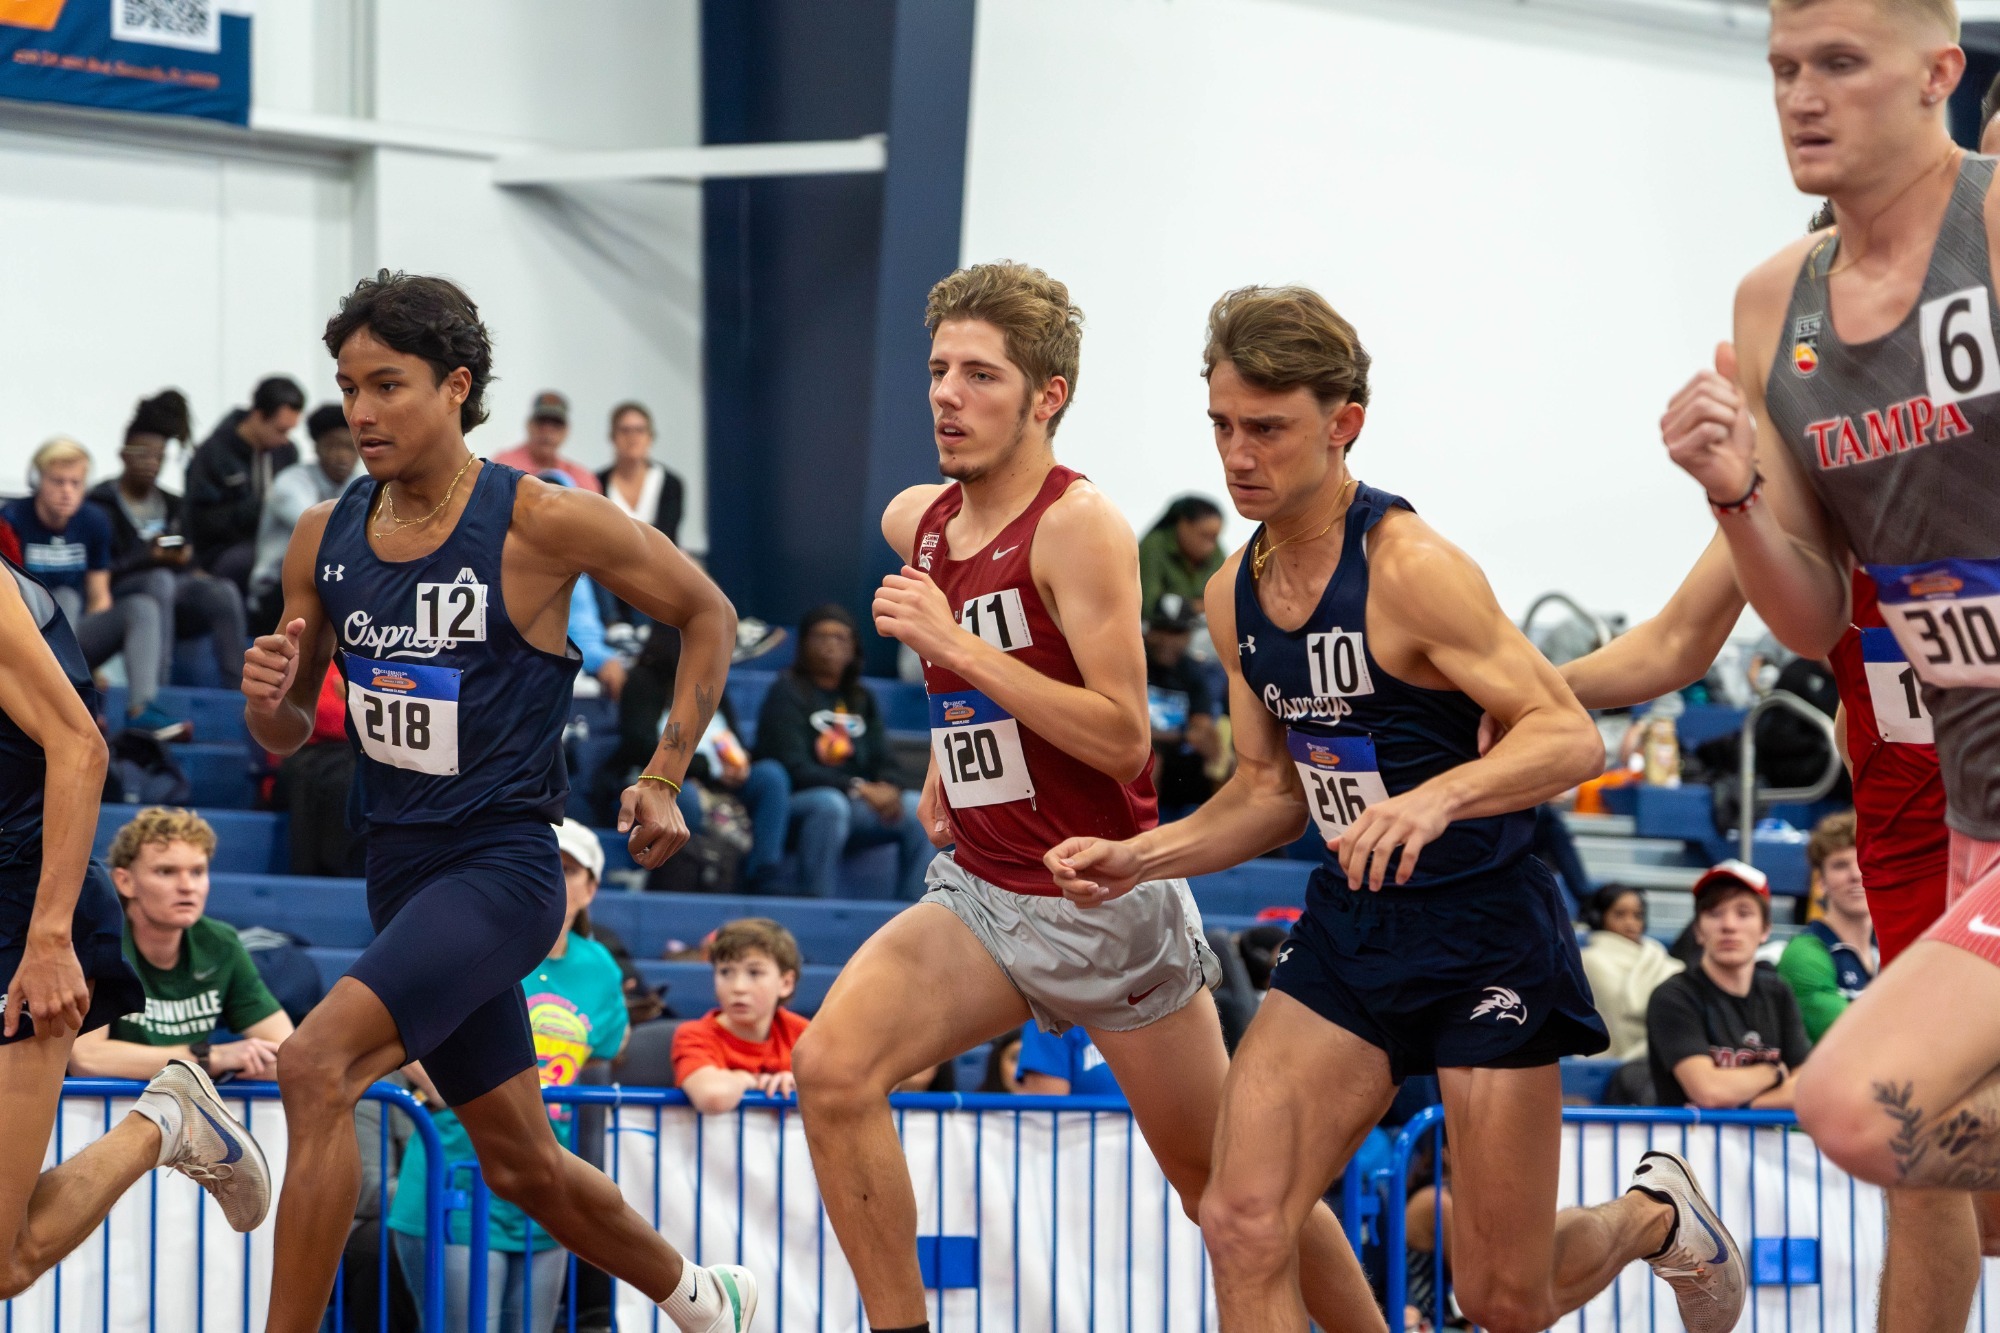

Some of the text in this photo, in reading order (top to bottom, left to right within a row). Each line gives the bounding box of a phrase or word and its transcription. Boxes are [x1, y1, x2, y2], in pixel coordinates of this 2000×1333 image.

[1939, 298, 1983, 394] 6
[1803, 396, 1974, 471] TAMPA
[421, 586, 476, 638] 12
[966, 594, 1012, 648] 11
[1903, 605, 2000, 665] 310
[1311, 635, 1359, 694] 10
[364, 694, 430, 751] 218
[944, 728, 1003, 783] 120
[1310, 771, 1367, 826] 216
